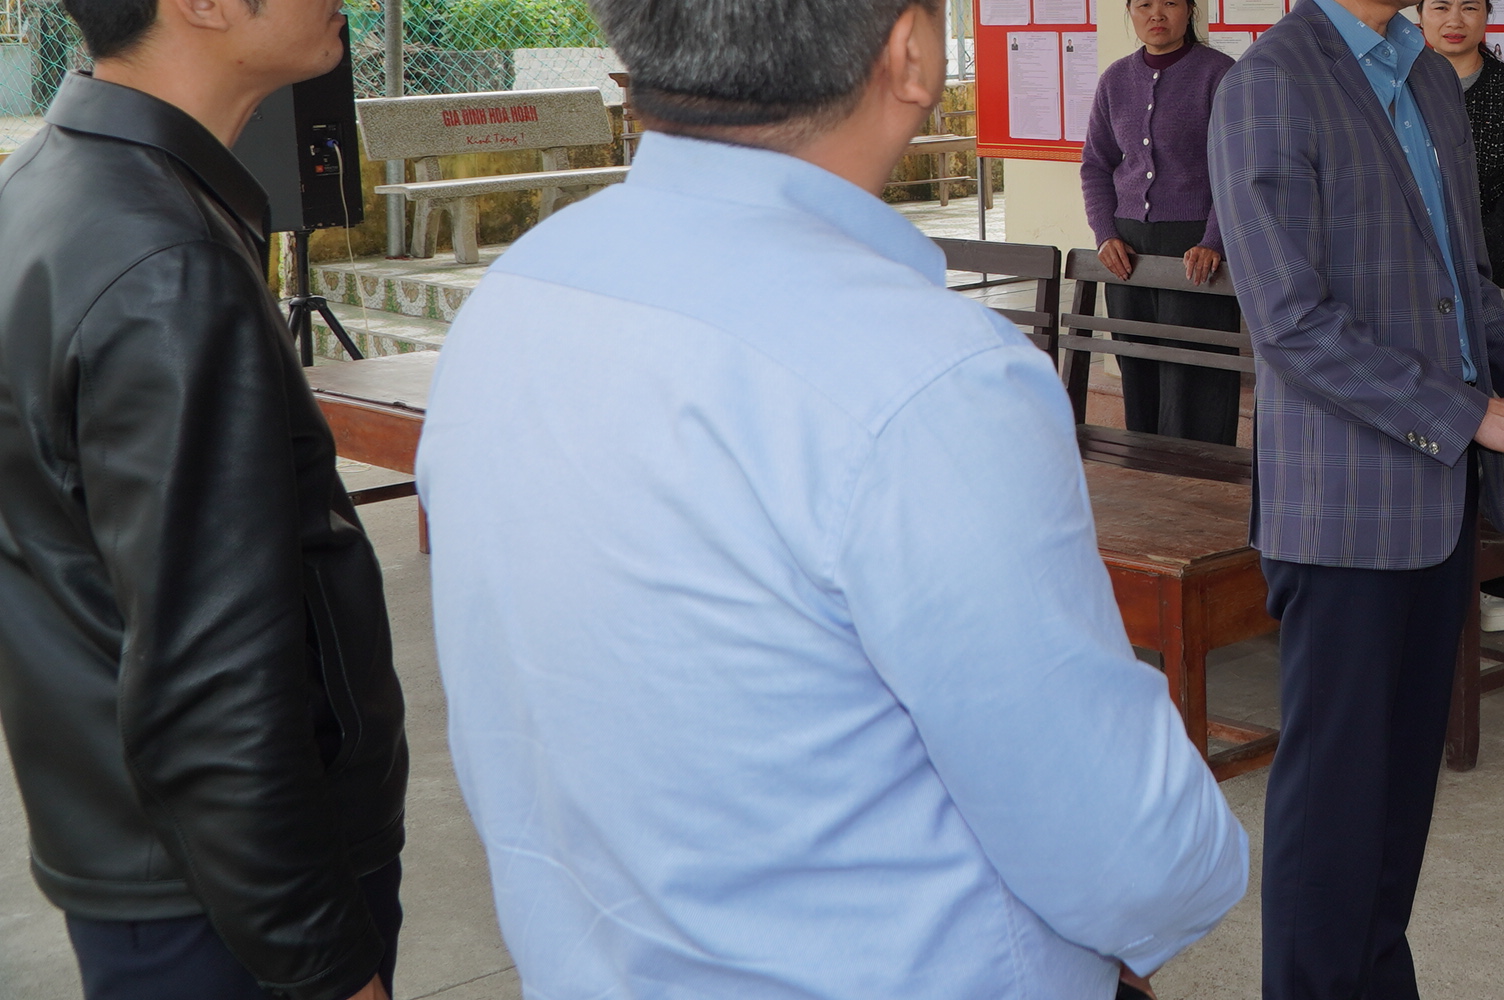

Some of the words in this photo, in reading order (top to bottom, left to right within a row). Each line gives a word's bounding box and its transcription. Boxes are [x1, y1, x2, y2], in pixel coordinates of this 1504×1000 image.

[442, 109, 461, 127] GIA
[461, 105, 487, 125] ĐÌNH
[488, 107, 510, 124] HOA
